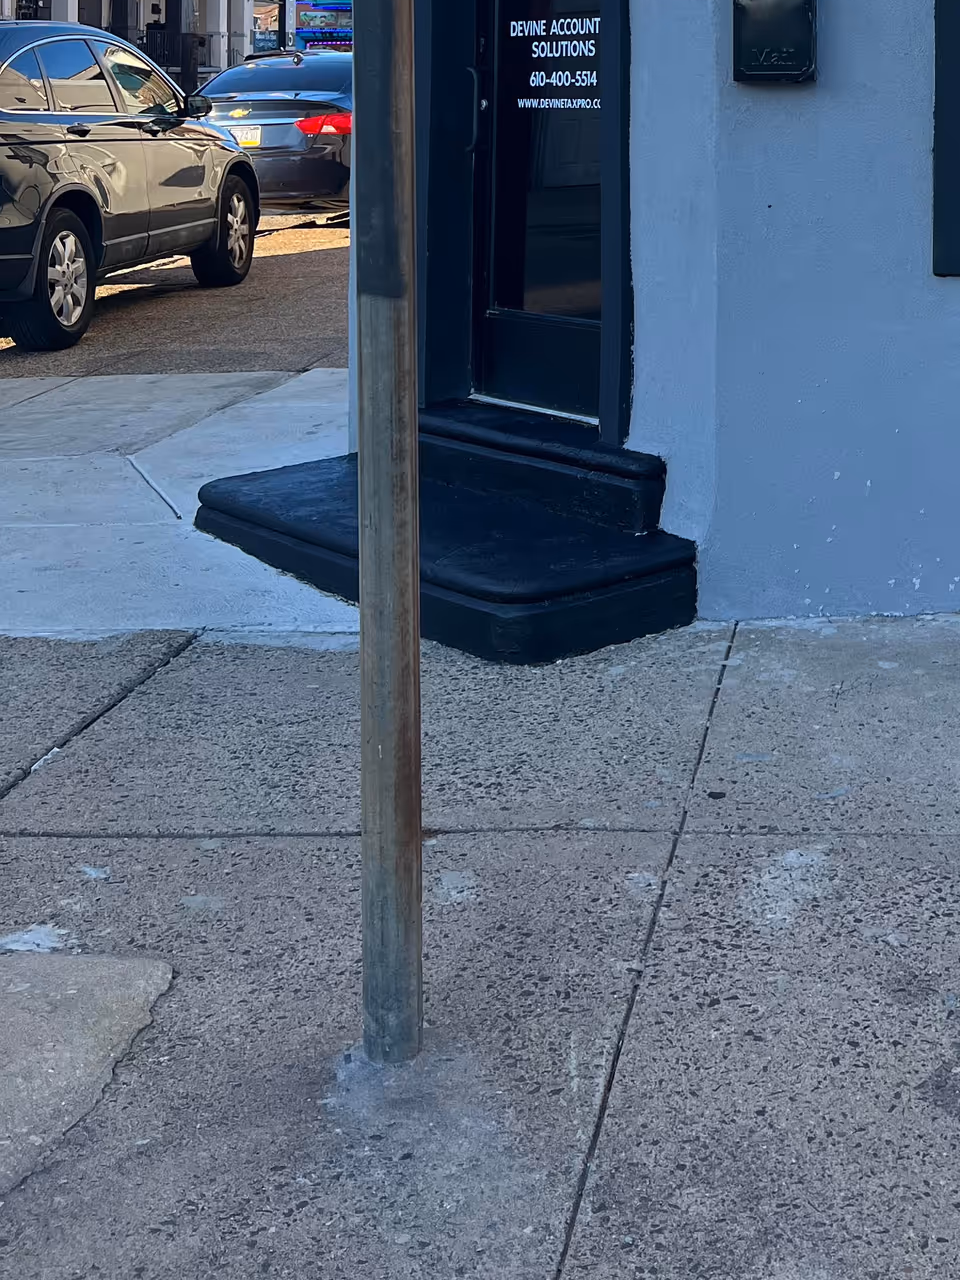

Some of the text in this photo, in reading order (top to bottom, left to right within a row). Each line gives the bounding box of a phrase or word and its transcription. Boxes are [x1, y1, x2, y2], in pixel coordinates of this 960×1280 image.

[510, 19, 547, 37] DEVINE
[531, 40, 596, 58] SOLUTIONS
[529, 70, 598, 87] 610-400-5514
